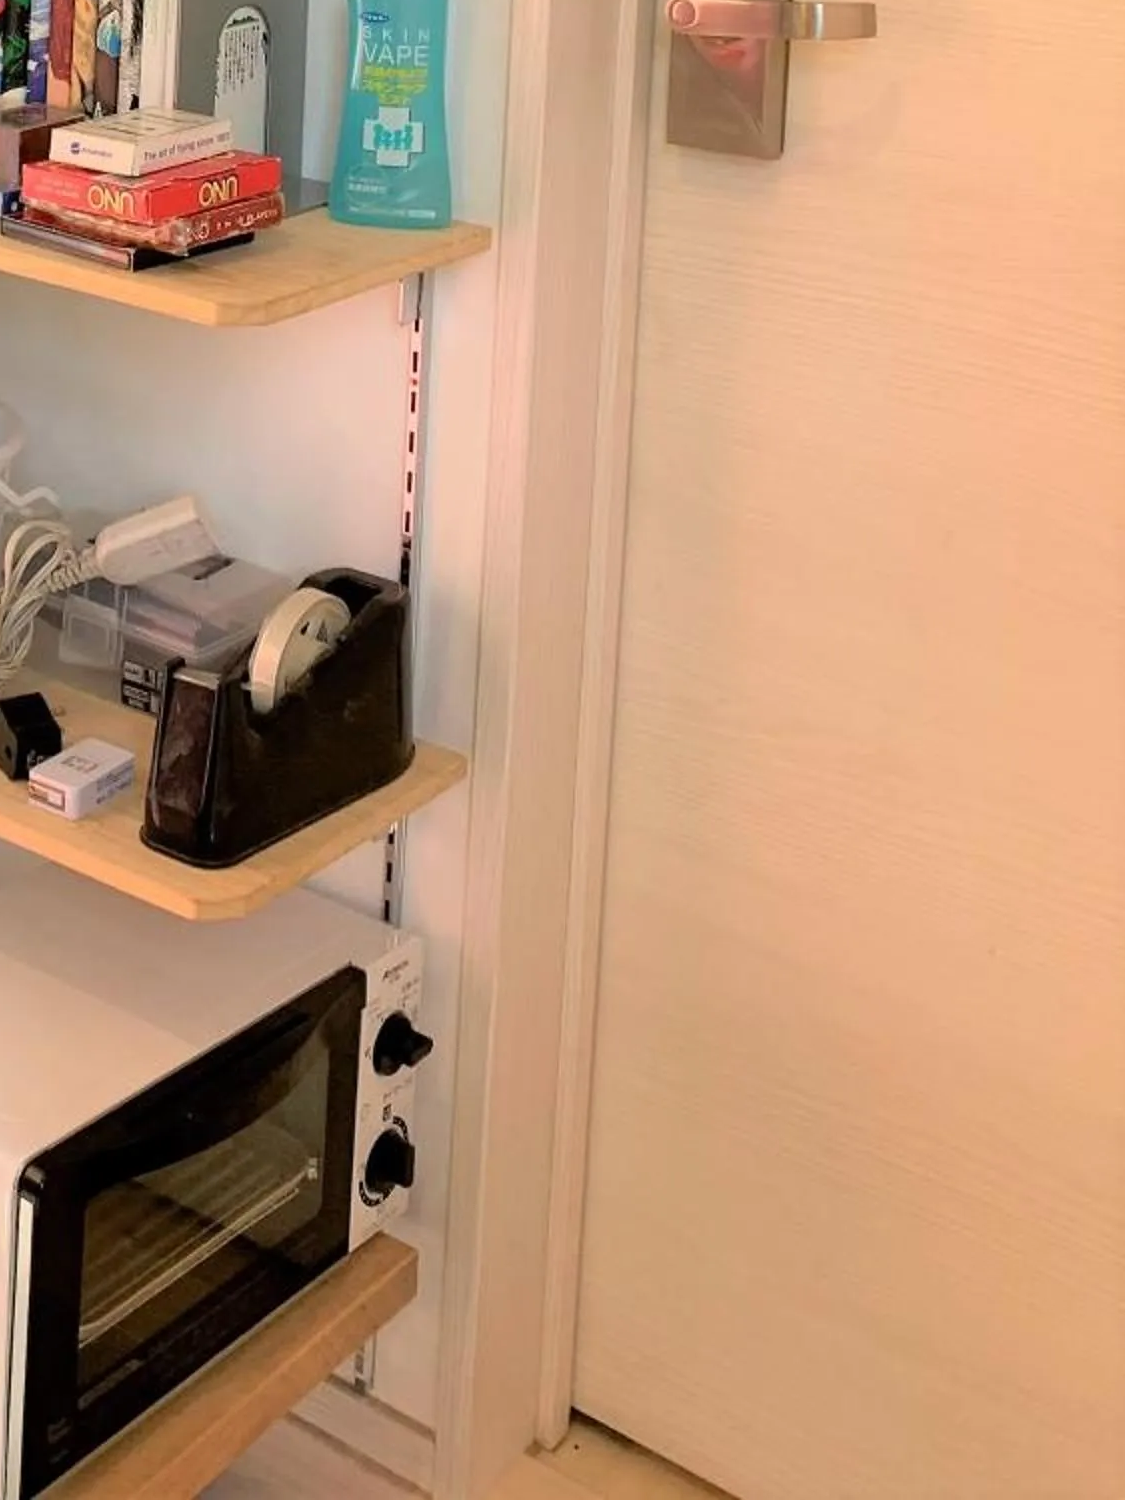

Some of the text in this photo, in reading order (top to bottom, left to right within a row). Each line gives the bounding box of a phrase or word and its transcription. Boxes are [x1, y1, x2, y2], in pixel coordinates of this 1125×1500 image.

[362, 25, 430, 43] SKIN
[362, 41, 430, 68] VAPE
[86, 183, 136, 218] UNO
[197, 174, 240, 208] UNO
